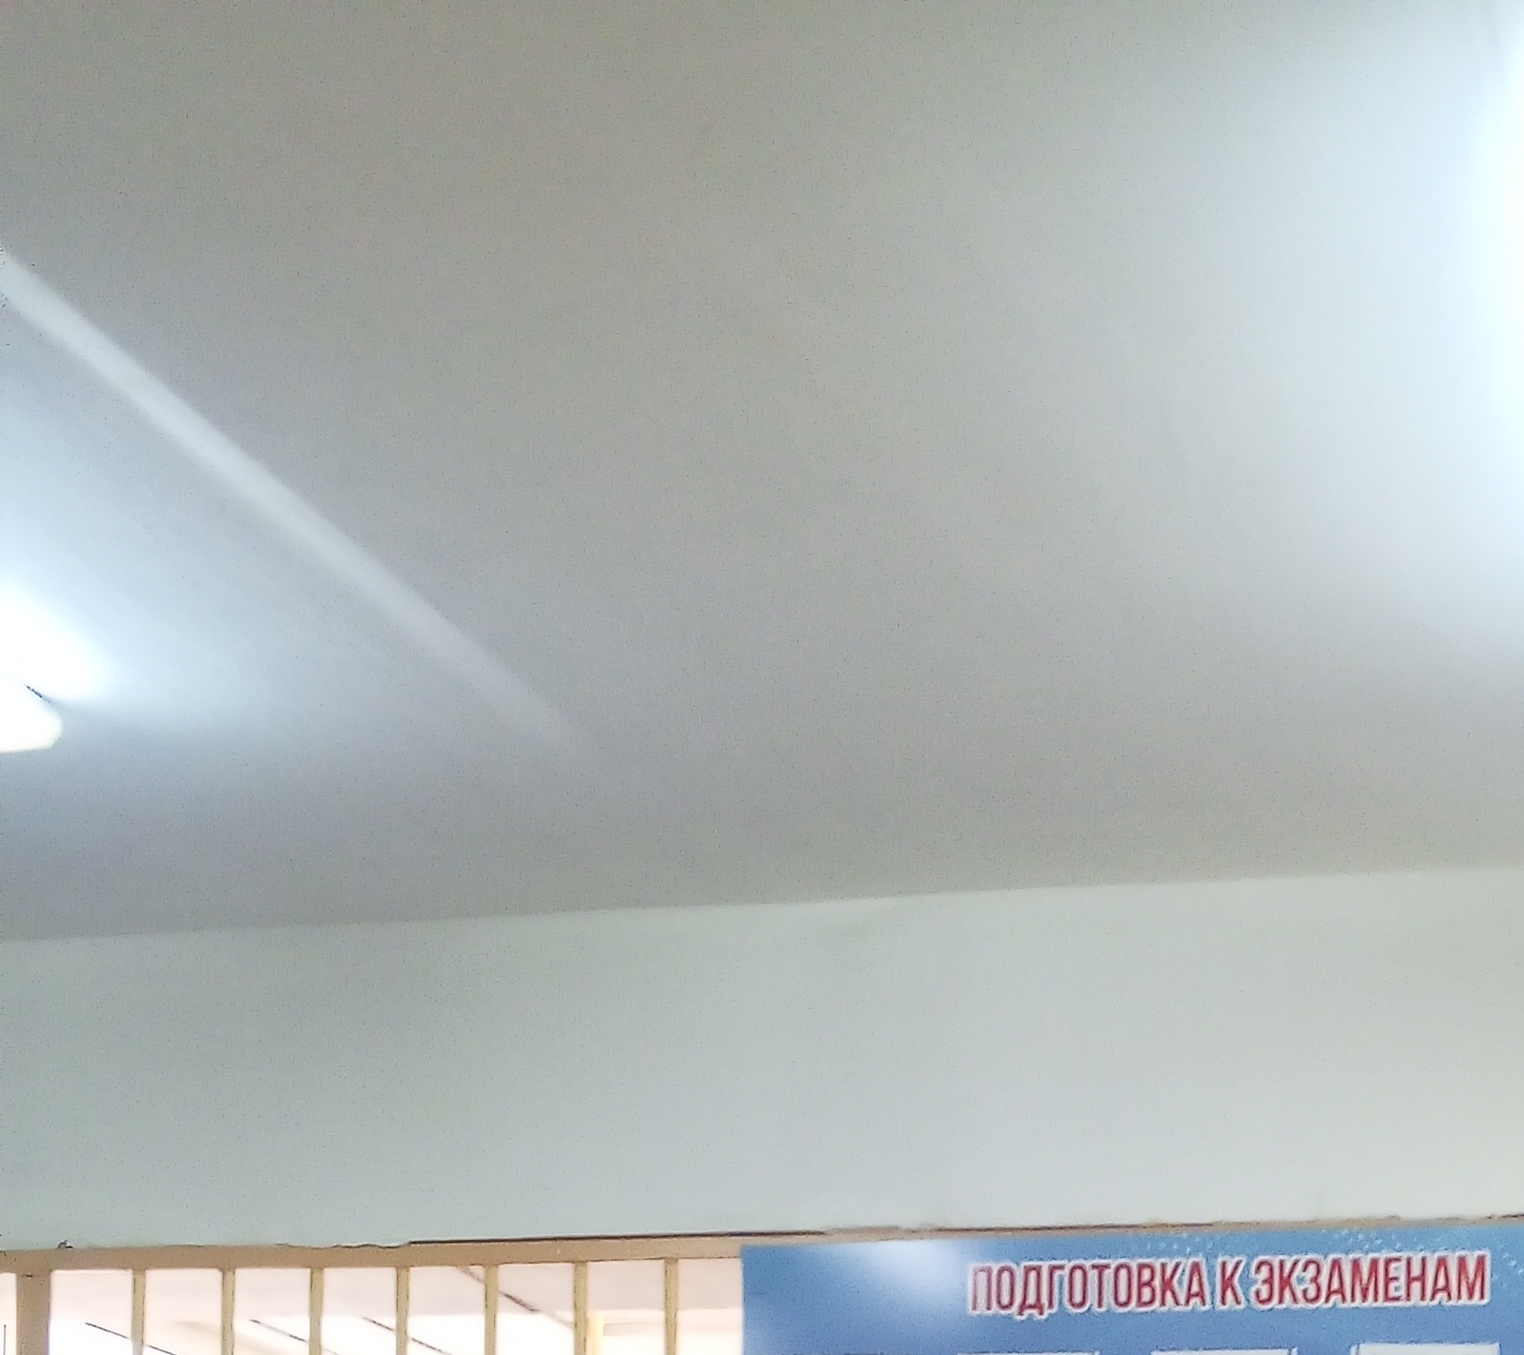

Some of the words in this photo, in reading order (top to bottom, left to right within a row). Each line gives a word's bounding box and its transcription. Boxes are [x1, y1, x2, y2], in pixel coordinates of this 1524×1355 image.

[969, 1258, 1211, 1319] ПОДГОТОВКА
[1217, 1257, 1246, 1307] К
[1252, 1251, 1489, 1306] ЭКЗАМЕНАМ
